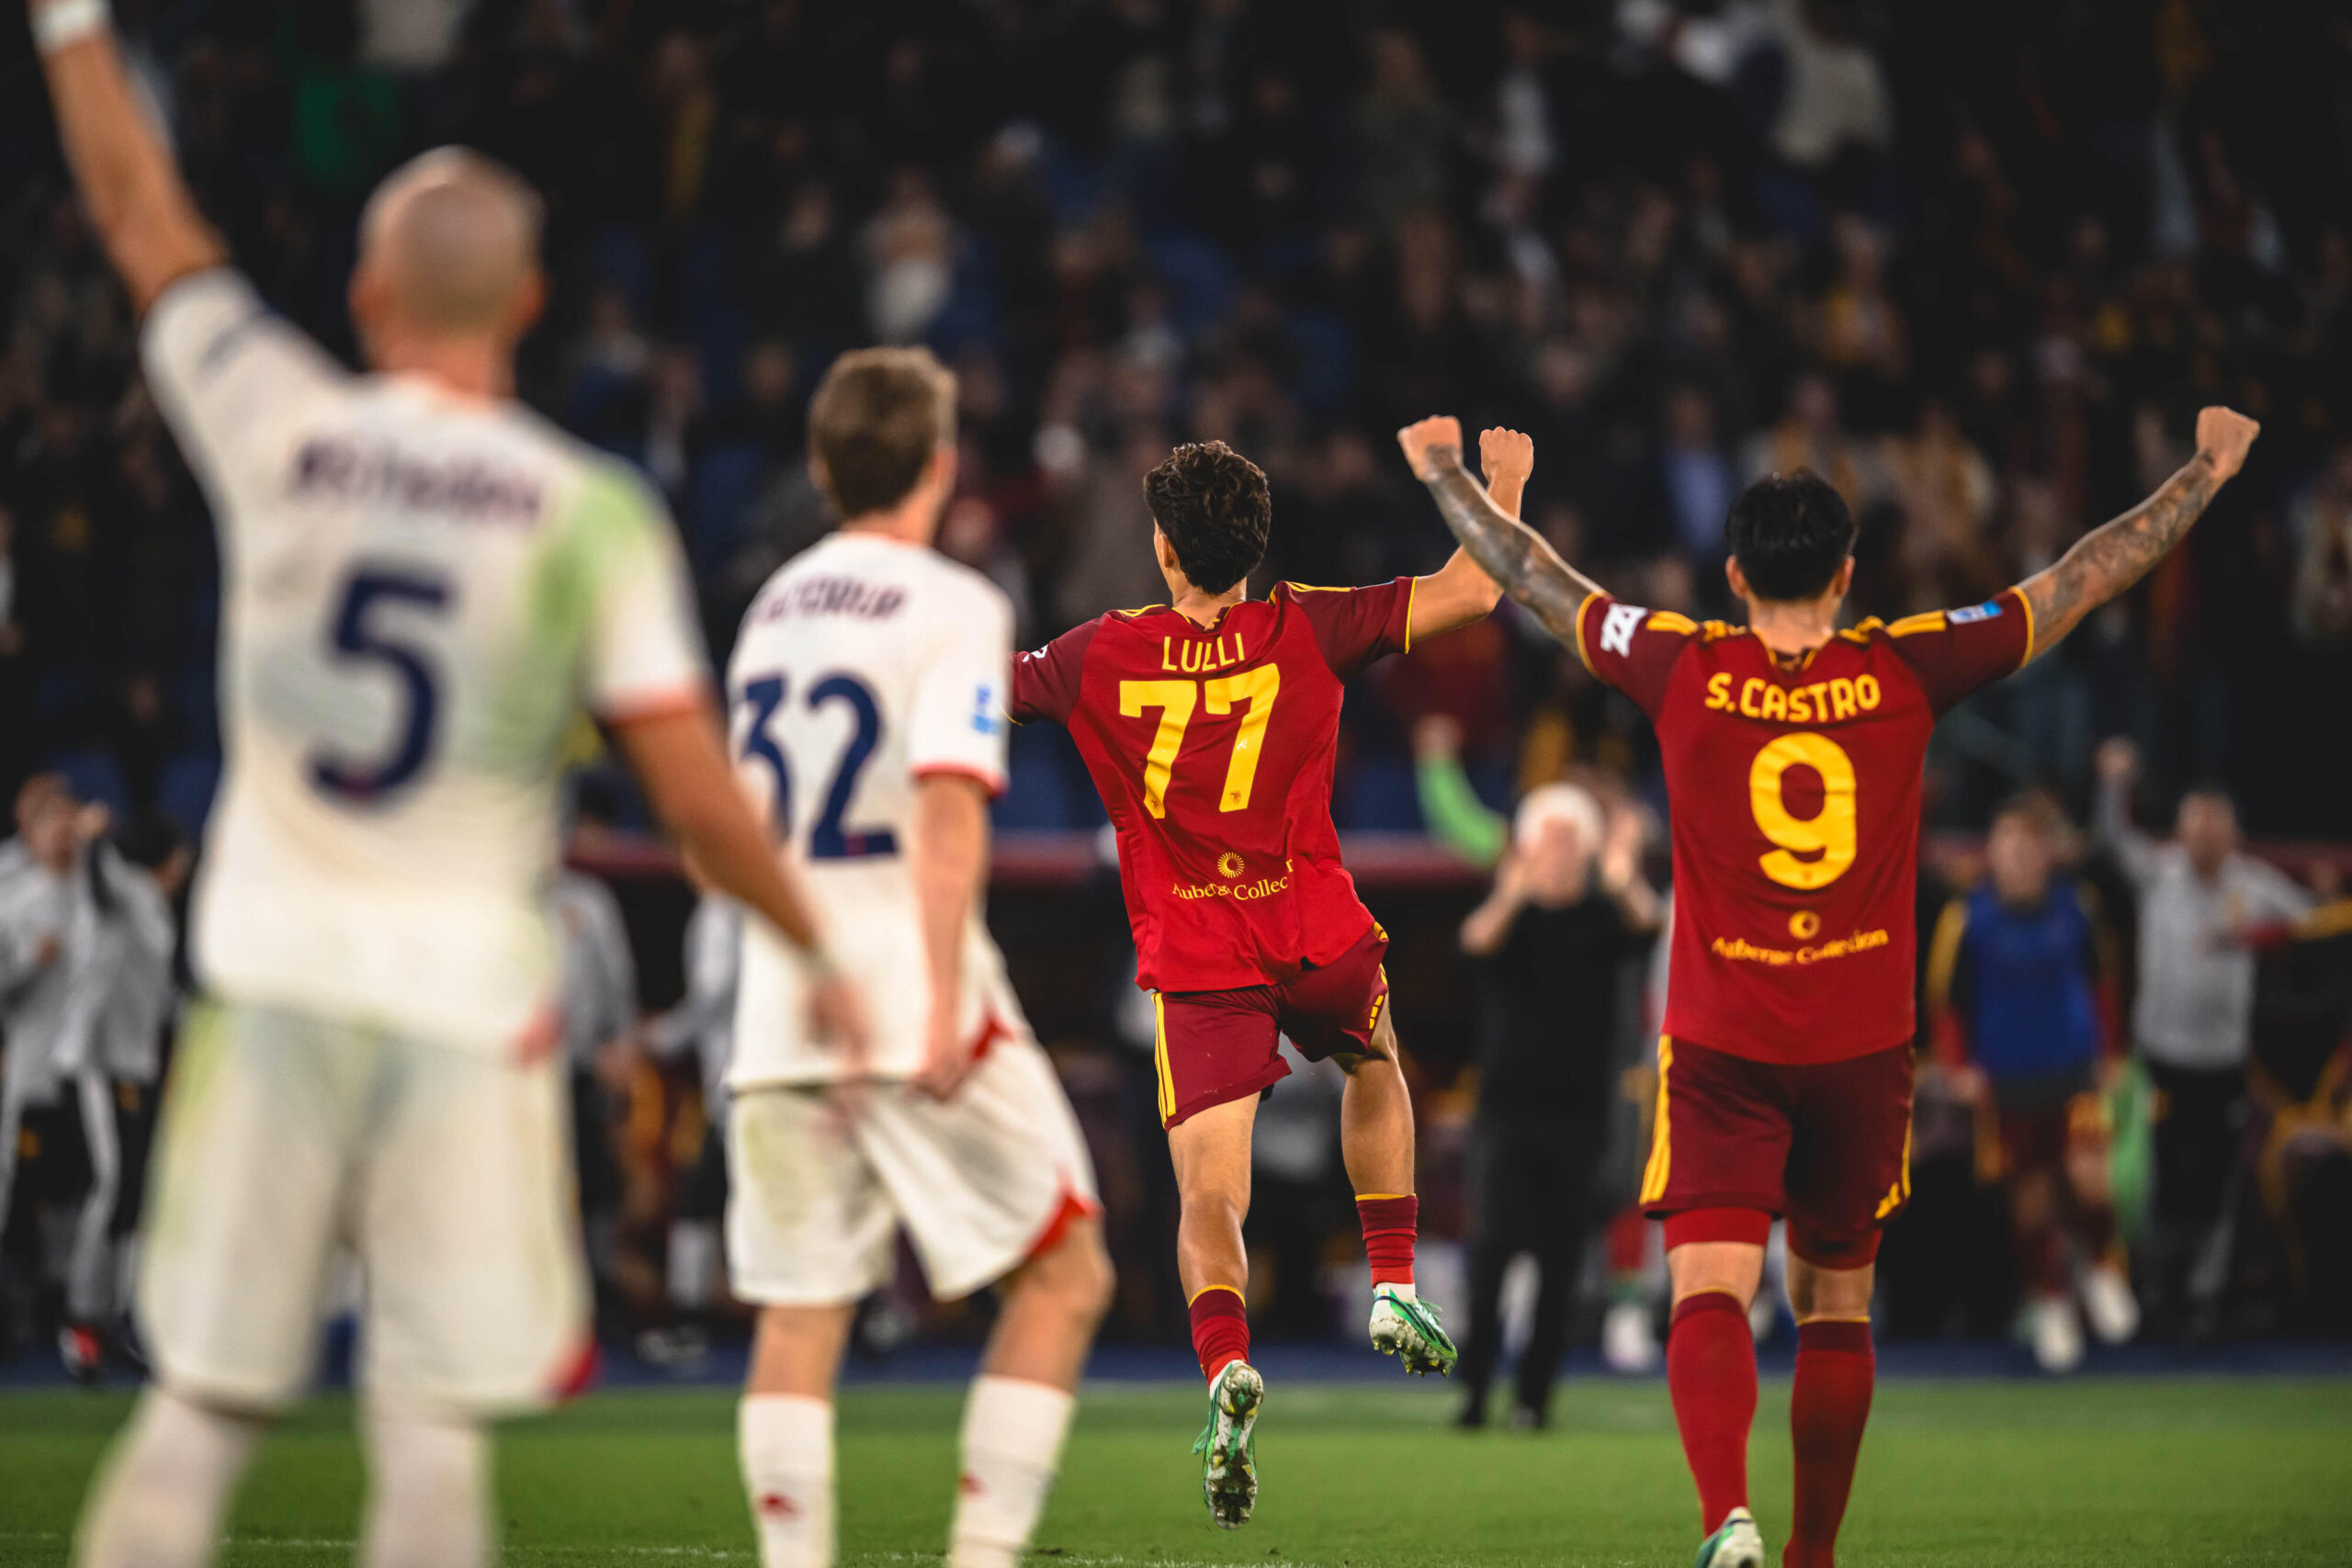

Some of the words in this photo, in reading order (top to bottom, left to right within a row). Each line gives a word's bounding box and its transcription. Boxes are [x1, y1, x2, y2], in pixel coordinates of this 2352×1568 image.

[310, 570, 454, 800] 5
[1162, 633, 1245, 672] LULLI
[743, 670, 899, 859] 32
[1119, 662, 1280, 818] 77
[1749, 731, 1857, 890] 9
